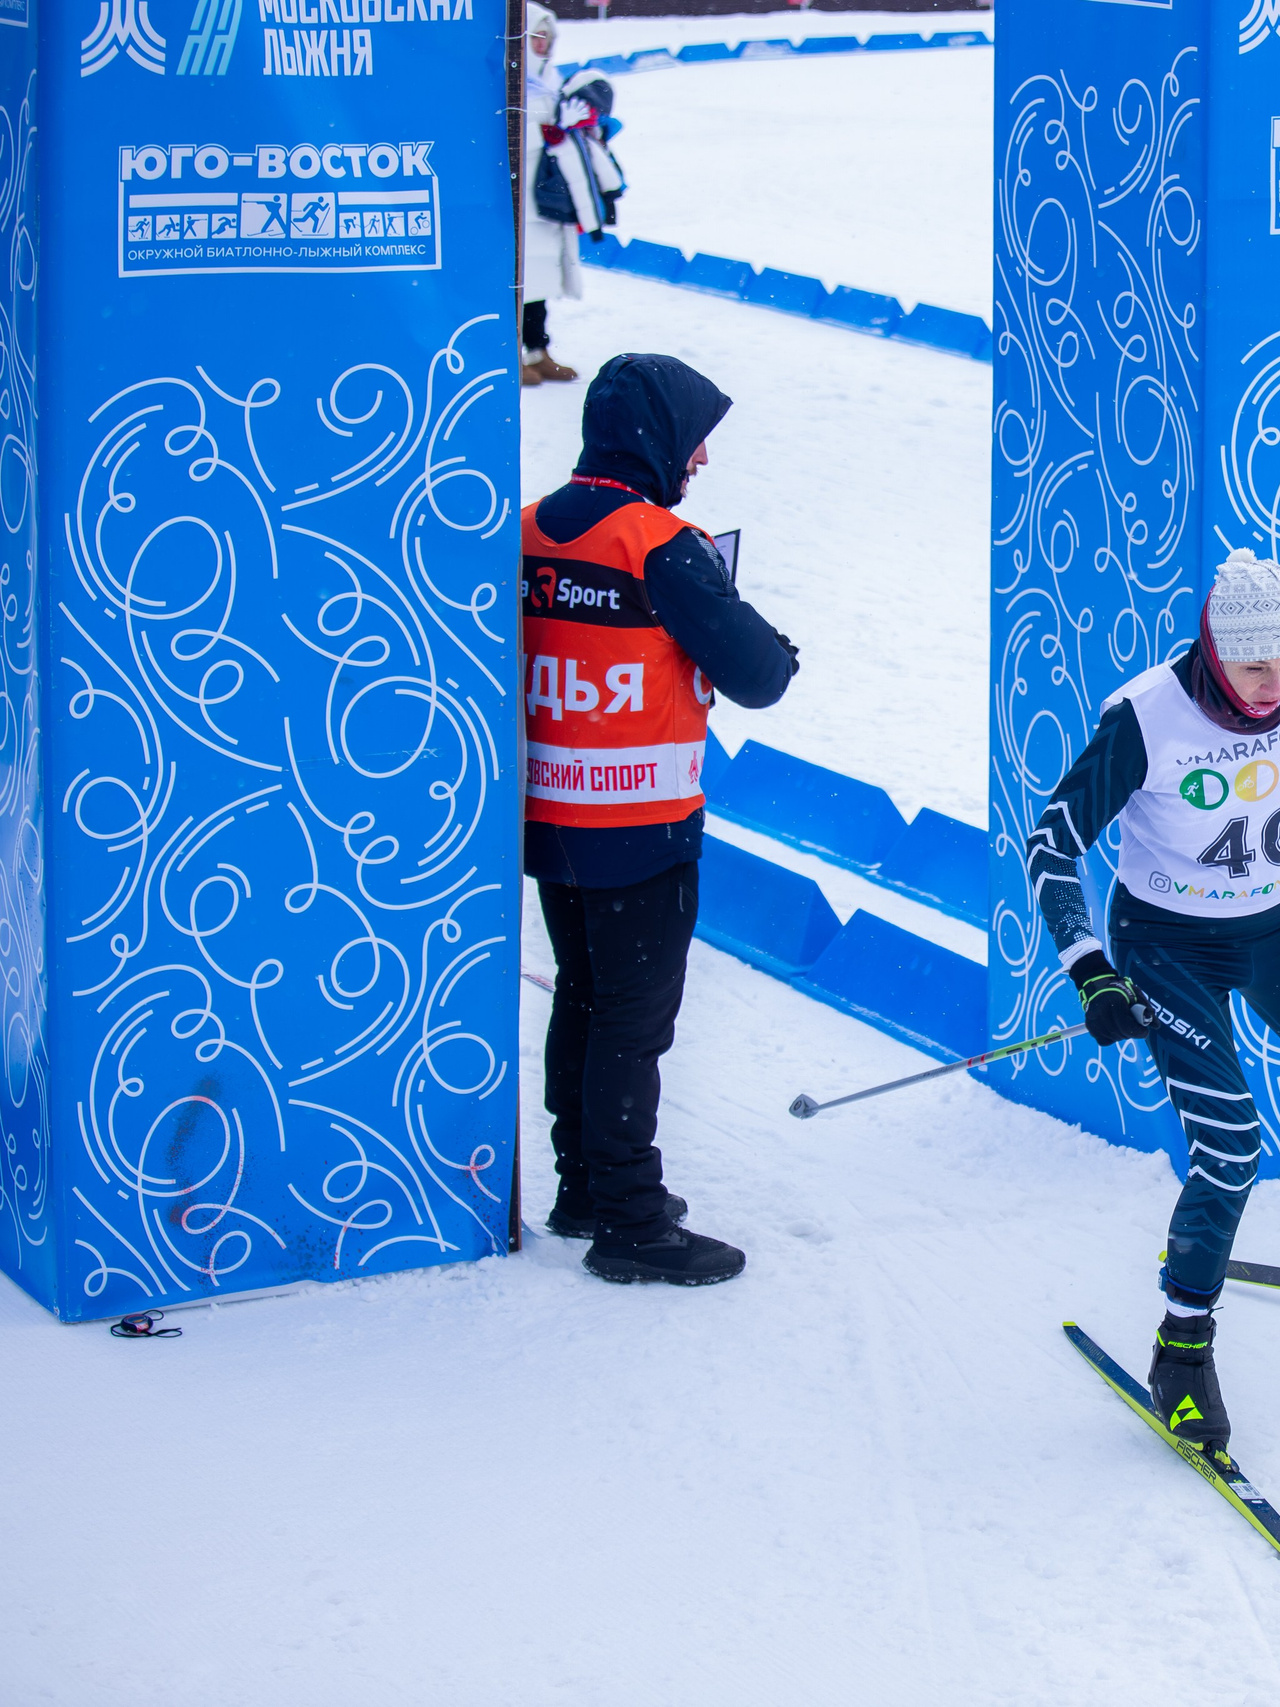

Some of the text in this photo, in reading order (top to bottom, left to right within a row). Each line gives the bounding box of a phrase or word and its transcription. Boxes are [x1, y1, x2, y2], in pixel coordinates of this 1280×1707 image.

[263, 28, 373, 76] ЛЫЖНЯ
[121, 144, 433, 181] ЮГО-ВОСТОК
[128, 243, 426, 260] ОКРУЖНОЙ БИАТЛОННО-ЛЫЖНЫЙ КОМПЛЕКС
[557, 578, 620, 610] Sport
[523, 654, 644, 721] ДЬЯ
[590, 763, 657, 791] СПОРТ
[1141, 990, 1212, 1050] RDSKI
[1167, 1340, 1208, 1349] FISCHER
[1176, 1440, 1217, 1484] FISCHER
